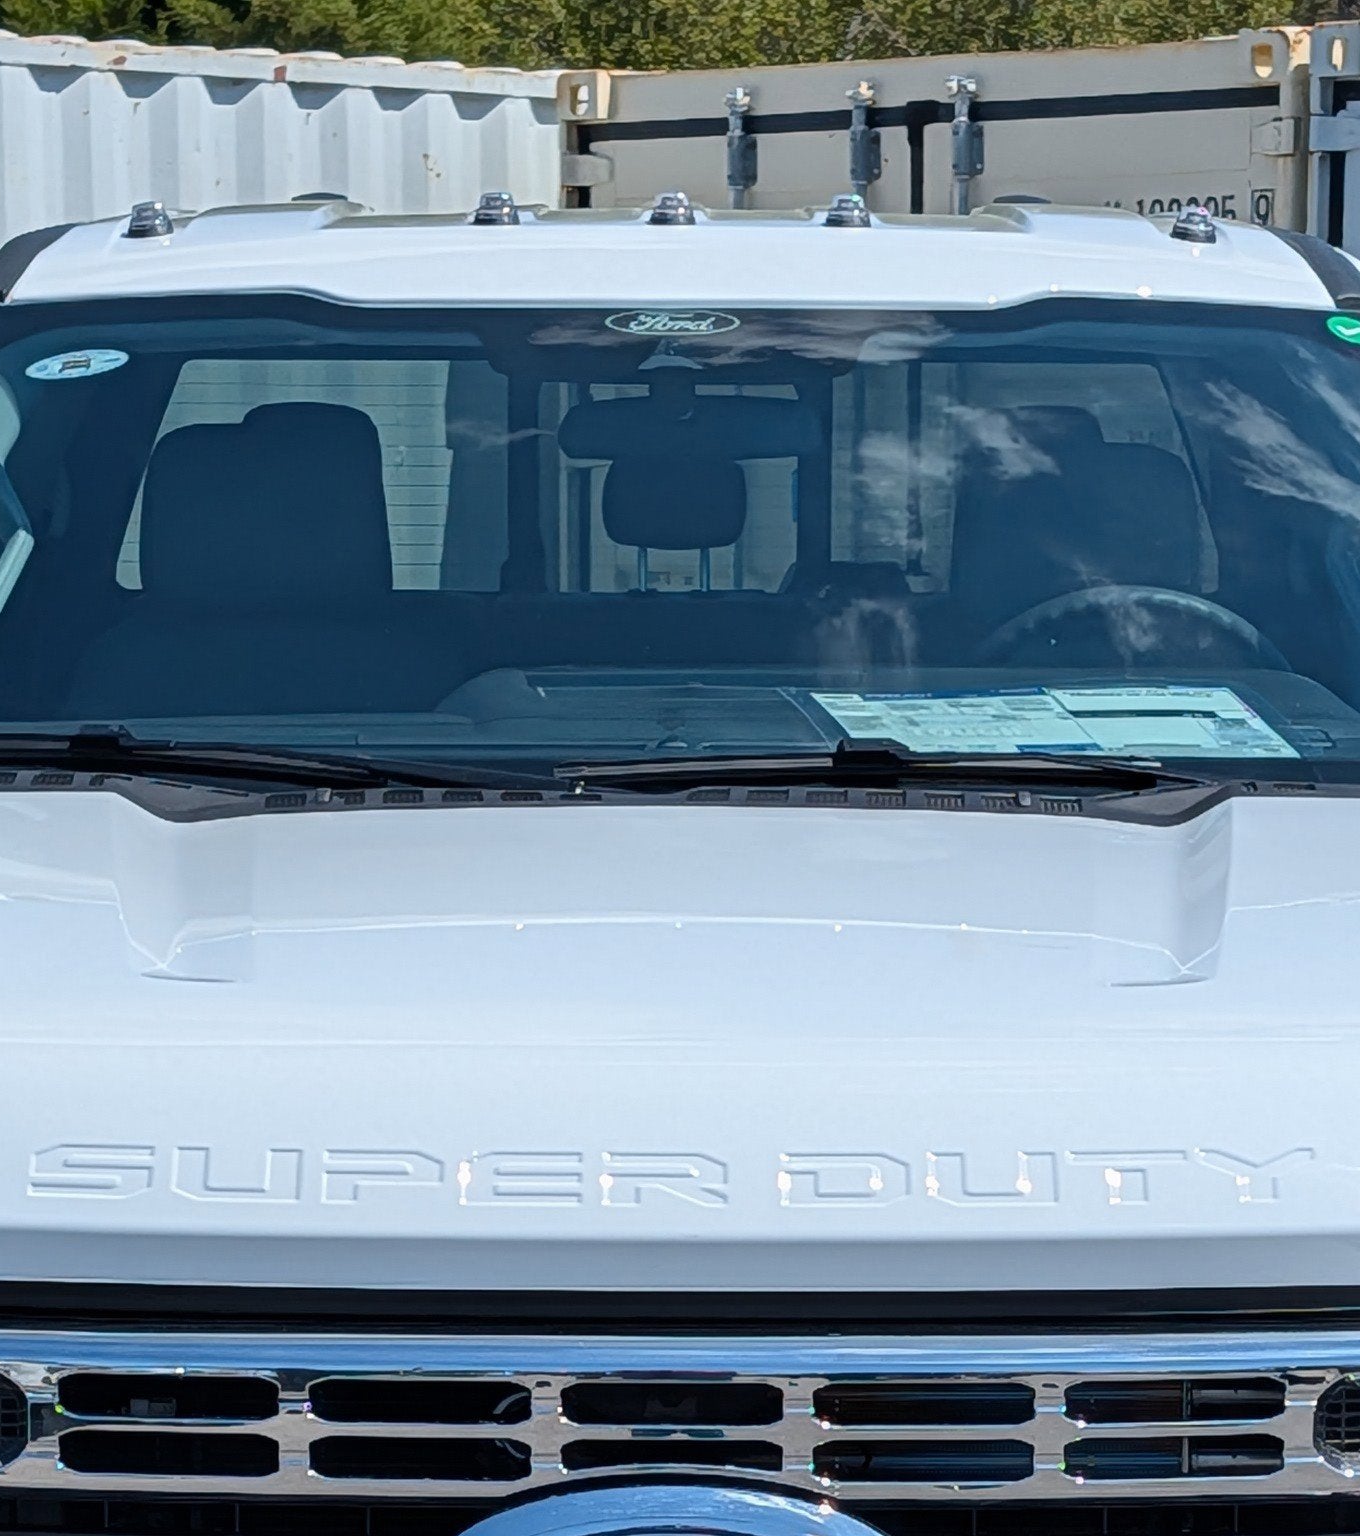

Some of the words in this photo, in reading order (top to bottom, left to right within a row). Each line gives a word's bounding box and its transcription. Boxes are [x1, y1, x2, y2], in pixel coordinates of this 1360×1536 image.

[629, 311, 716, 331] Ford
[27, 1144, 729, 1207] SUPER
[778, 1147, 1315, 1208] DUTY
